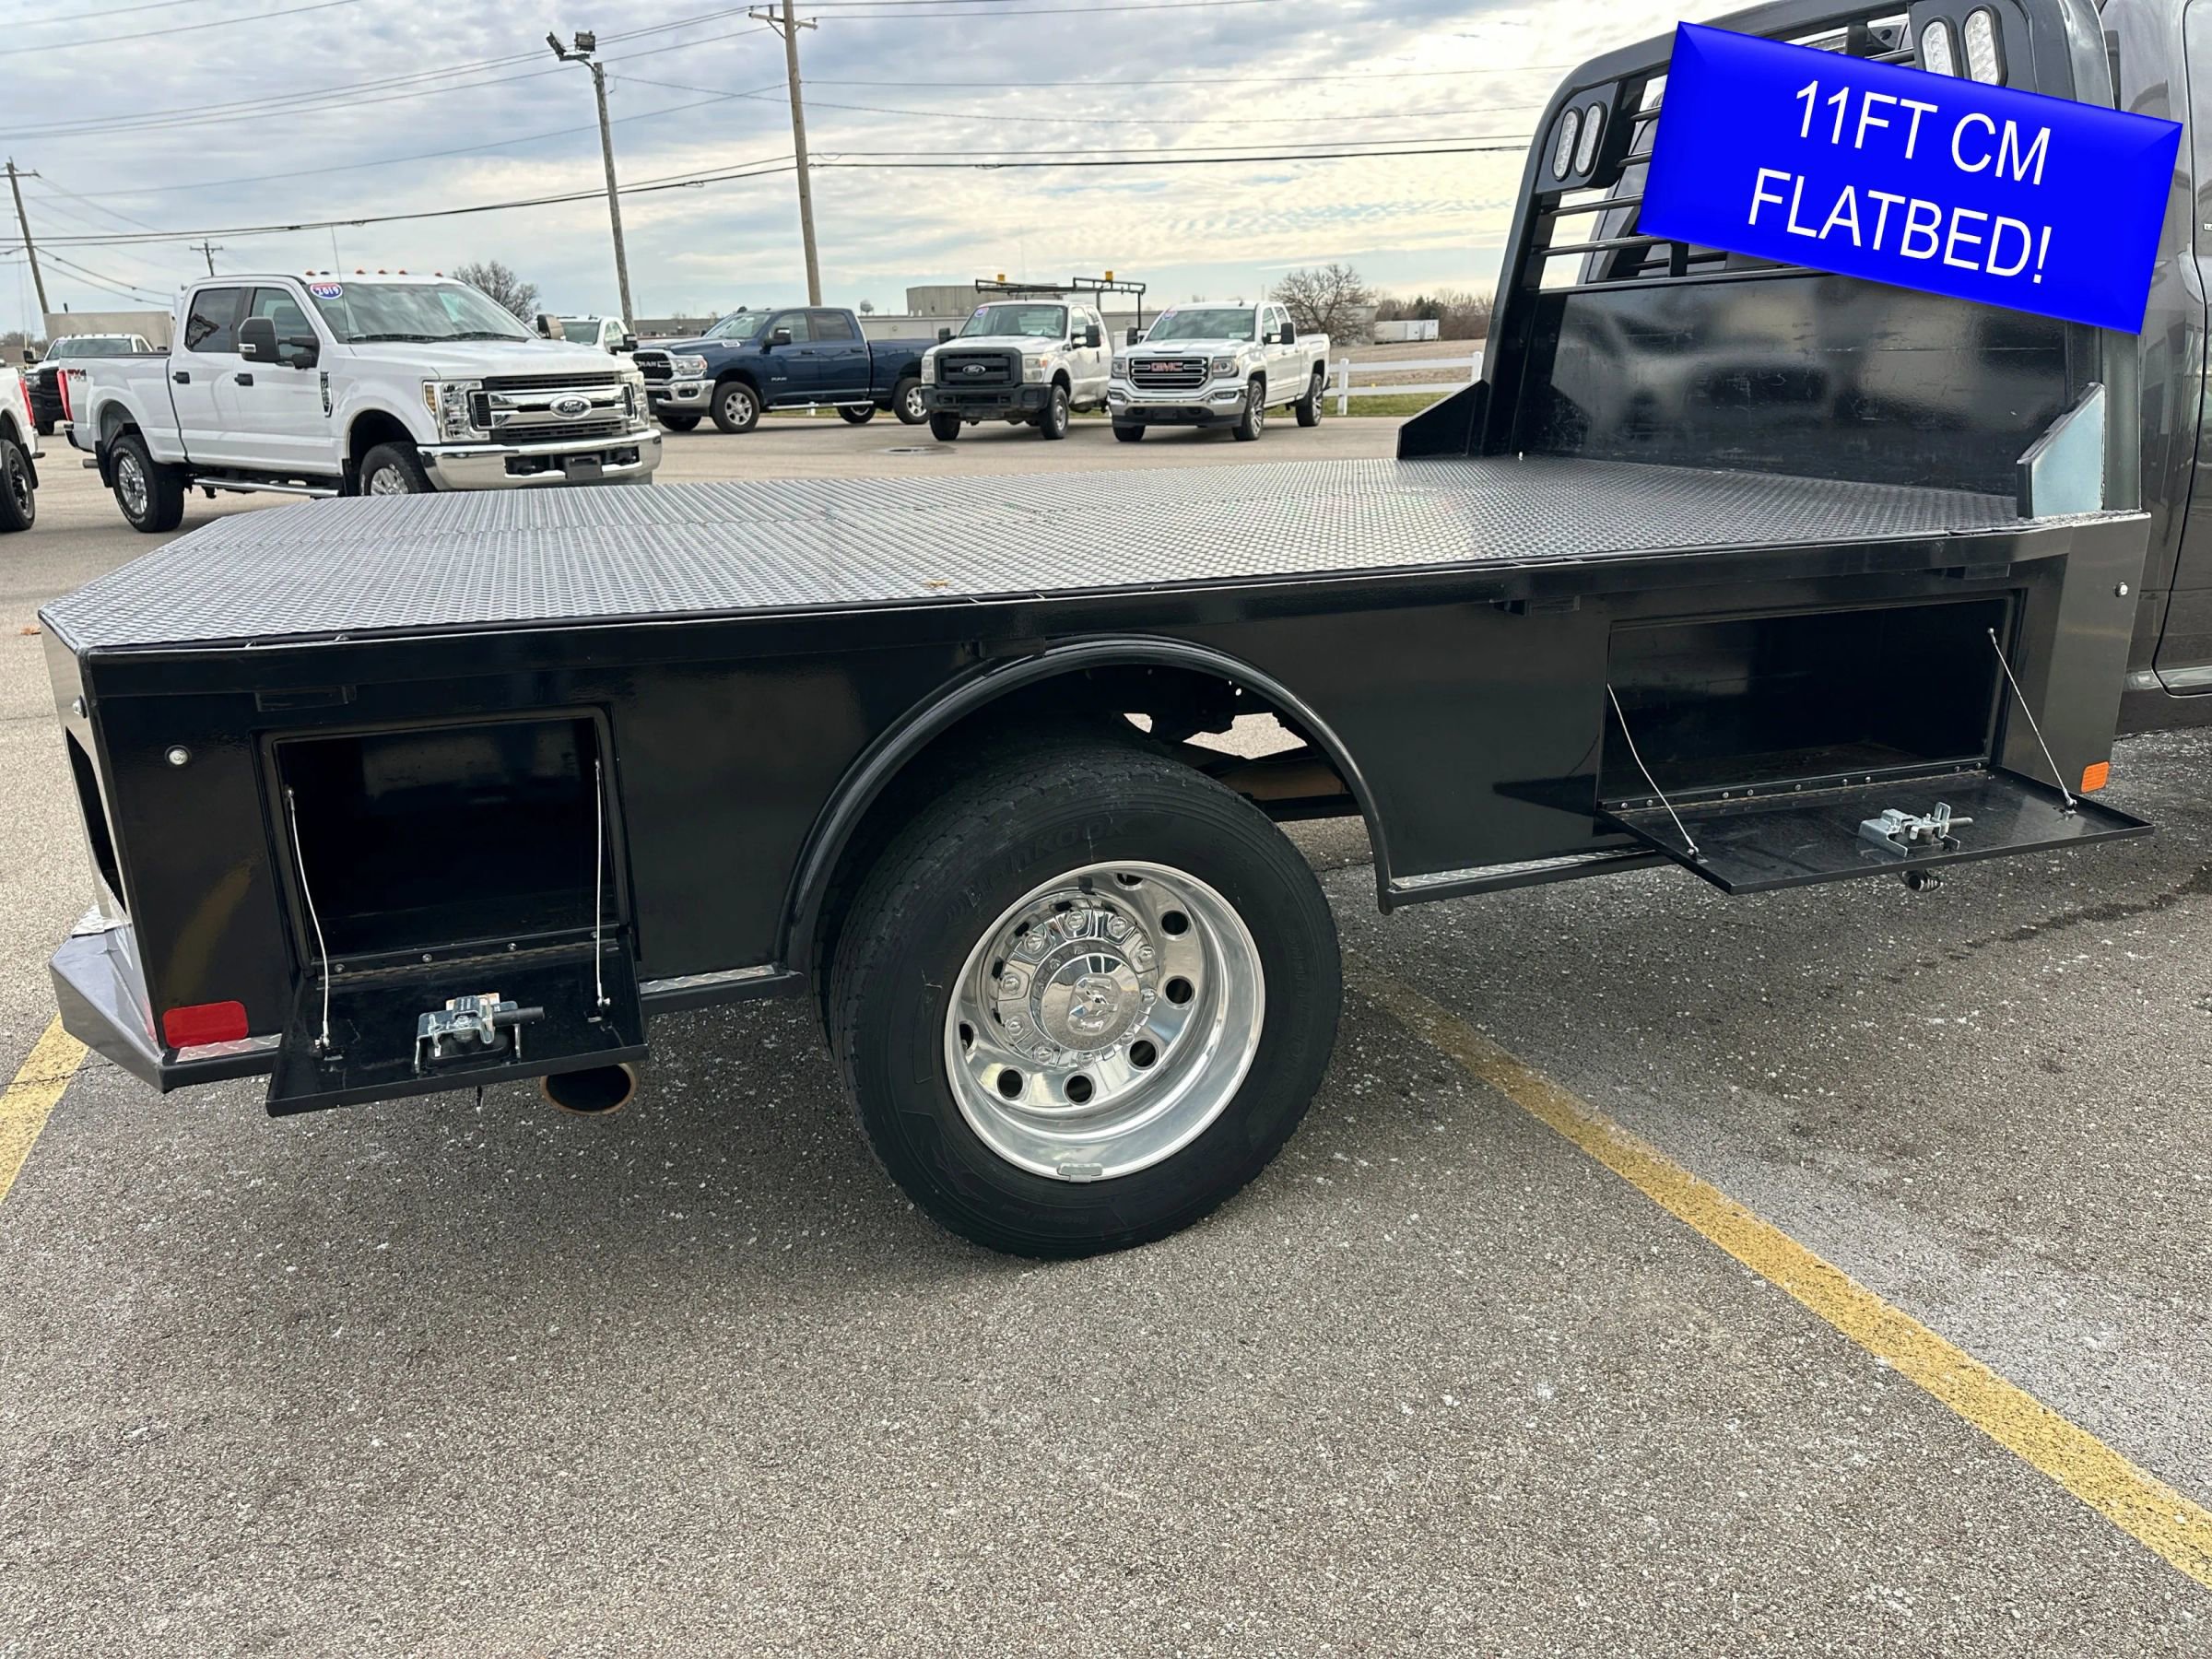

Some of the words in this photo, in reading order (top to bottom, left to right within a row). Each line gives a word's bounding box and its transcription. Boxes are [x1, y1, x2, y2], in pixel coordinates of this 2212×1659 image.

[315, 287, 340, 295] 2019
[1151, 362, 1183, 371] GMC
[562, 400, 583, 412] Ford
